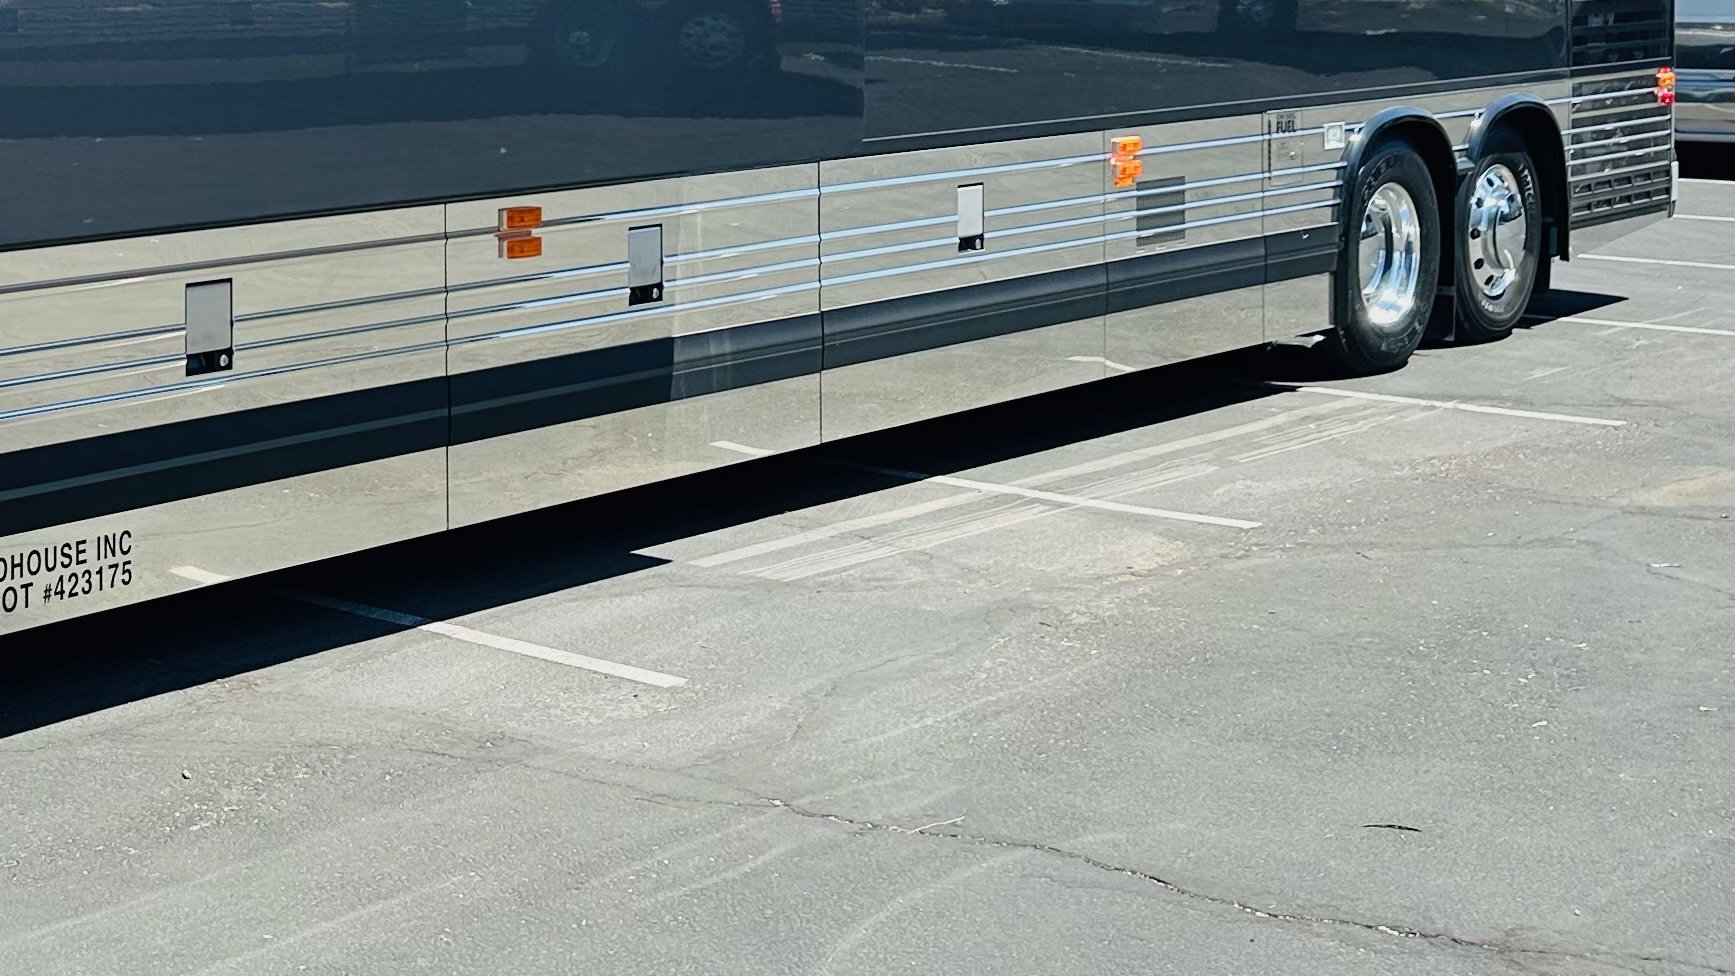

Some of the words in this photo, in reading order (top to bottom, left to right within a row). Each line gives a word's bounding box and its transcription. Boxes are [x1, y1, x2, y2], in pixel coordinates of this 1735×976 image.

[1276, 120, 1296, 133] FUEL
[96, 530, 132, 561] INC
[42, 560, 133, 605] #423175
